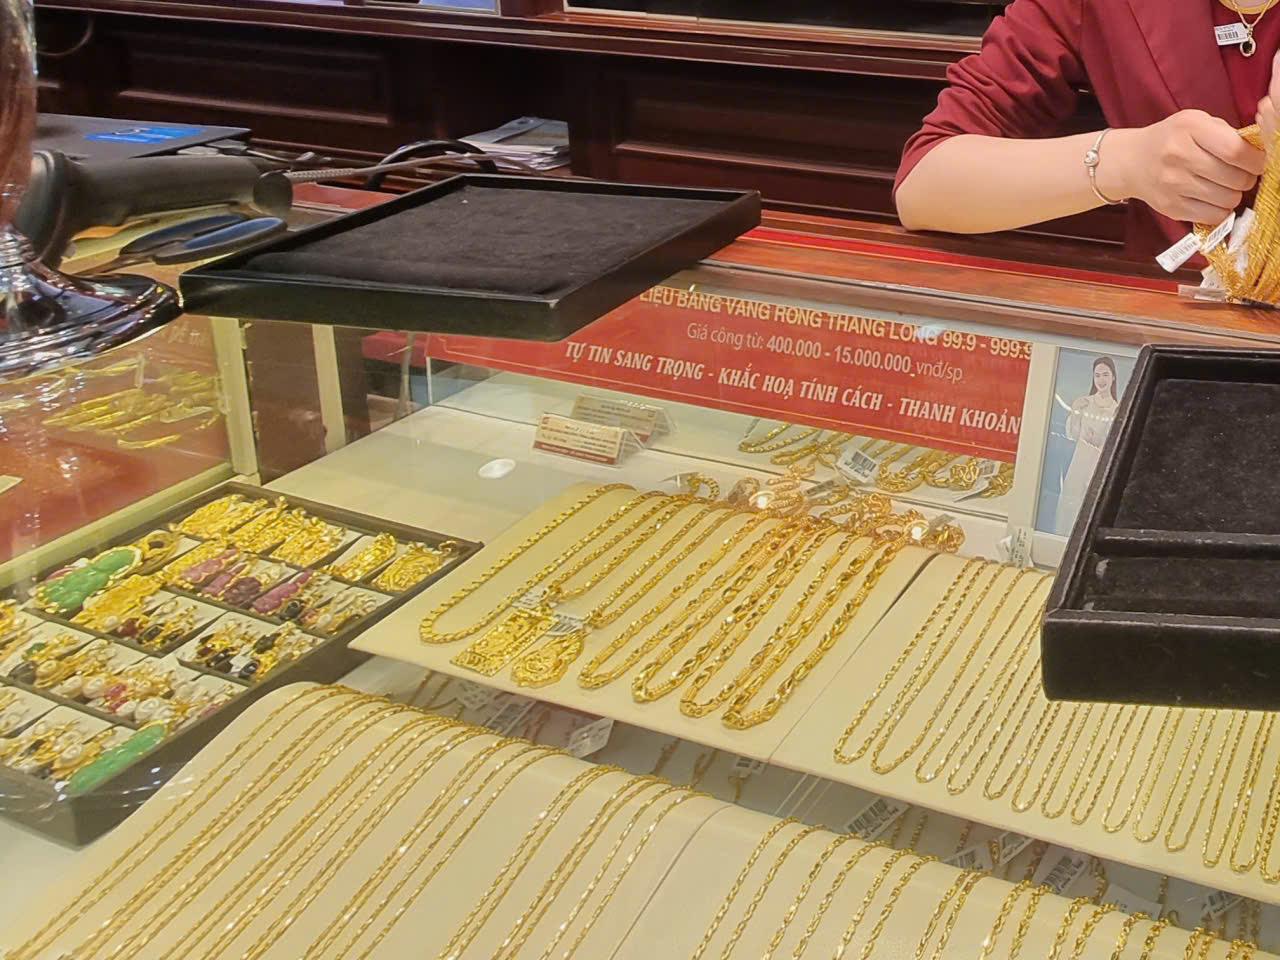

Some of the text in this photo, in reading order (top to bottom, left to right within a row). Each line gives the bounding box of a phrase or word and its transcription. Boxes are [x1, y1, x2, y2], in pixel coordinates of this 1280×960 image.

[687, 322, 707, 340] Giá
[710, 328, 744, 348] công
[766, 335, 822, 359] 400.000
[836, 346, 912, 373] 15.000.000
[566, 342, 1021, 435] TỰ TIN SANG TRỌNG KHẮC HOẠ TÍNH CÁCH THANH KHOẢN
